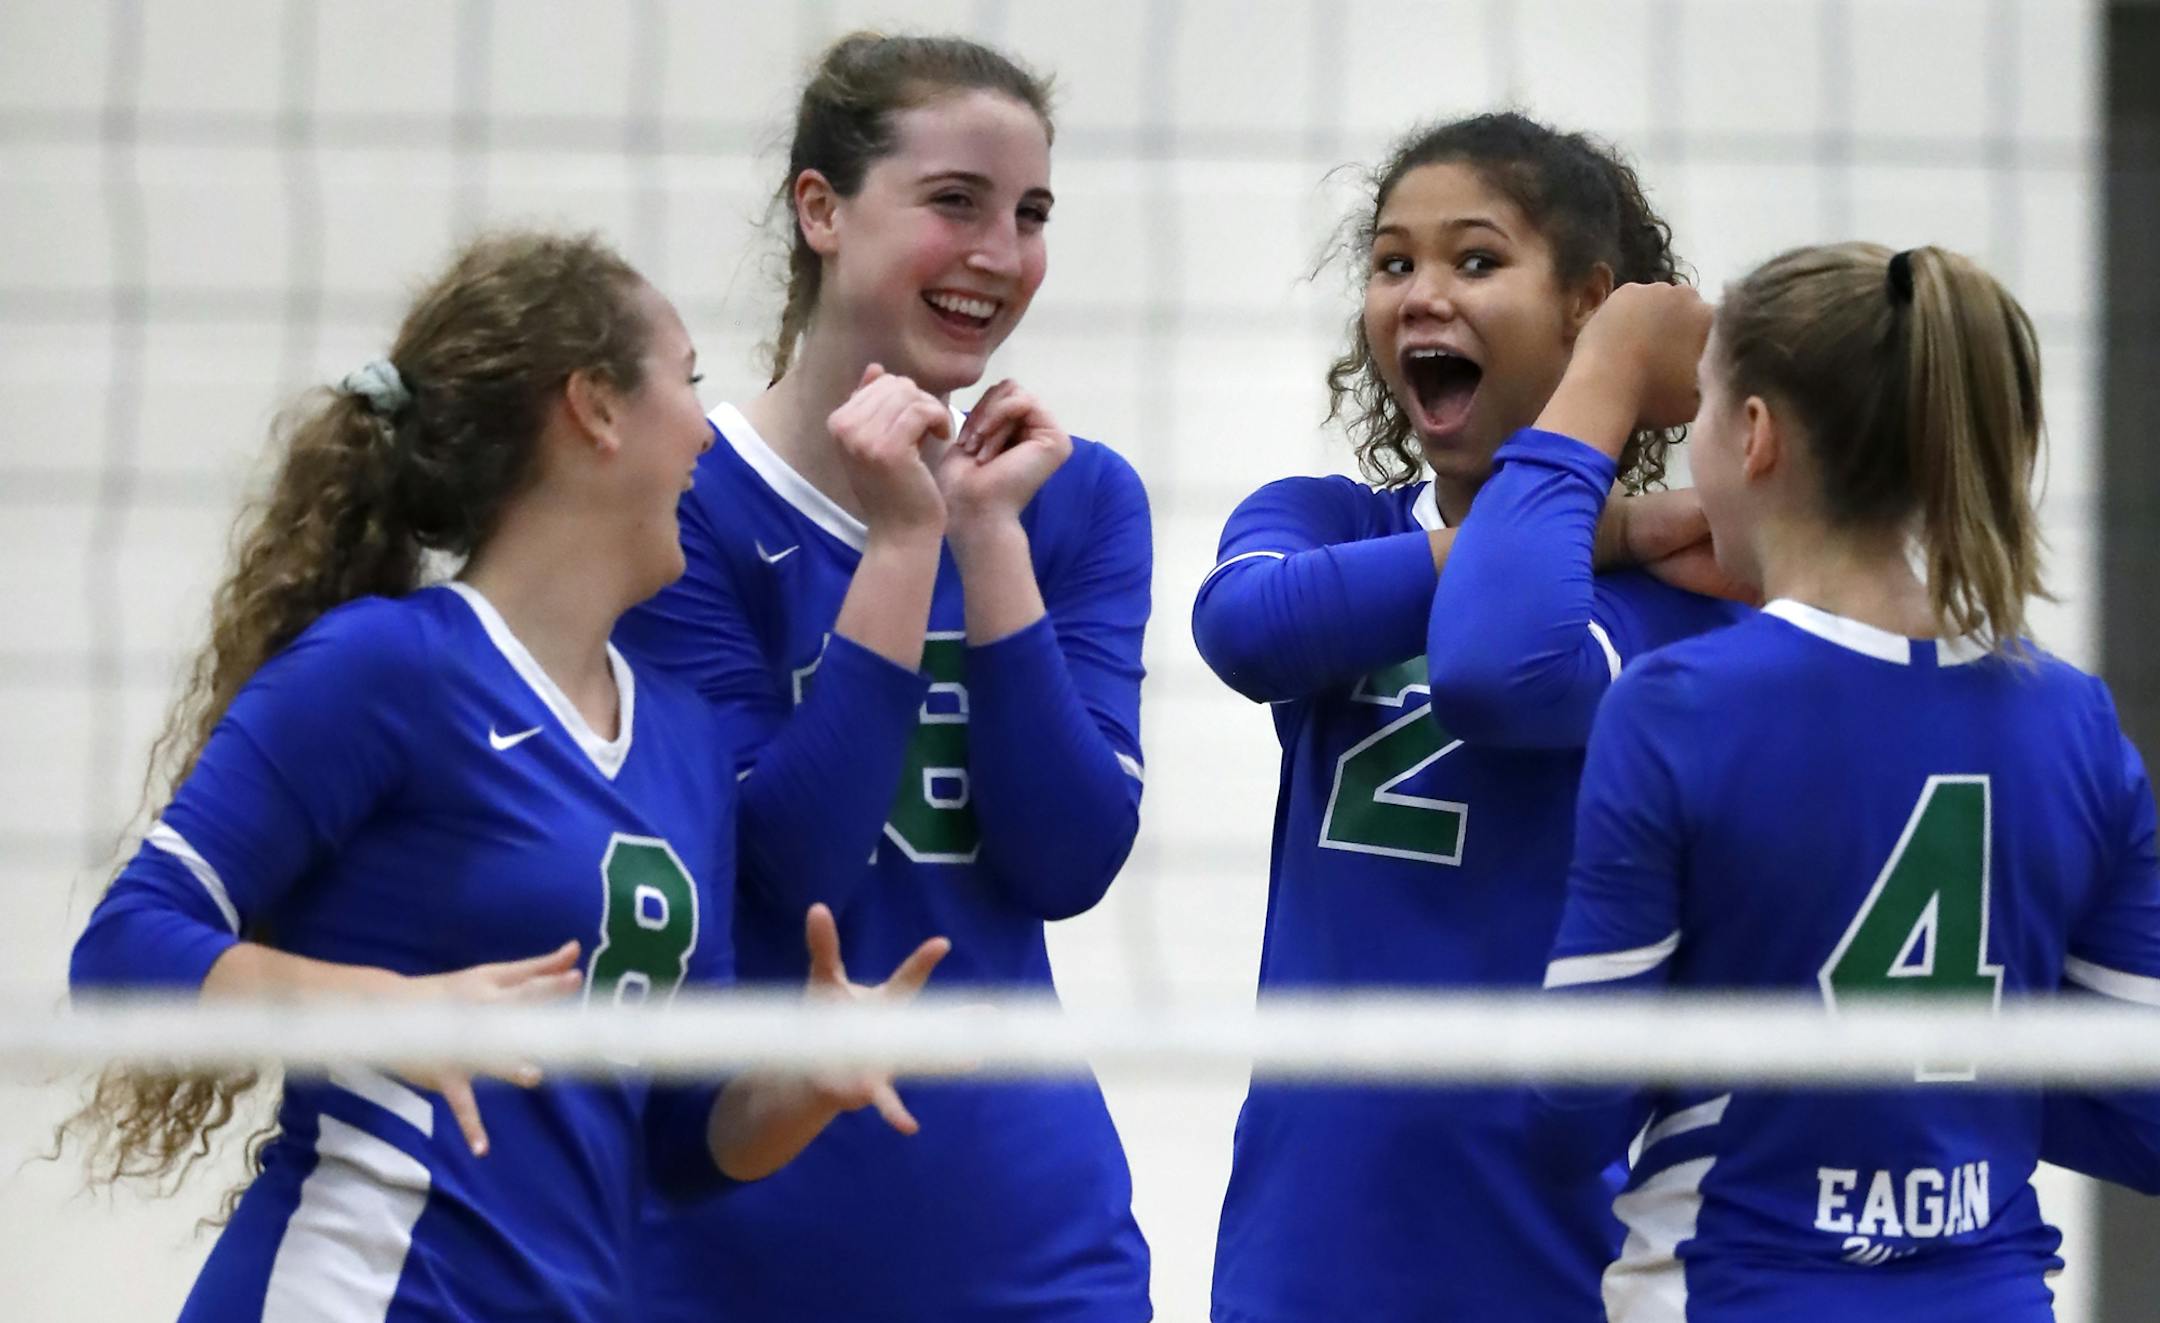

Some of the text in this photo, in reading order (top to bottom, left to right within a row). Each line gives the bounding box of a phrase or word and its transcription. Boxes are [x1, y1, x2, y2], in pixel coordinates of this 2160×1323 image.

[1318, 653, 1468, 867] 2
[583, 832, 699, 1062] 8
[1817, 774, 2005, 1082] 4
[1814, 1160, 1990, 1237] EAGAN
